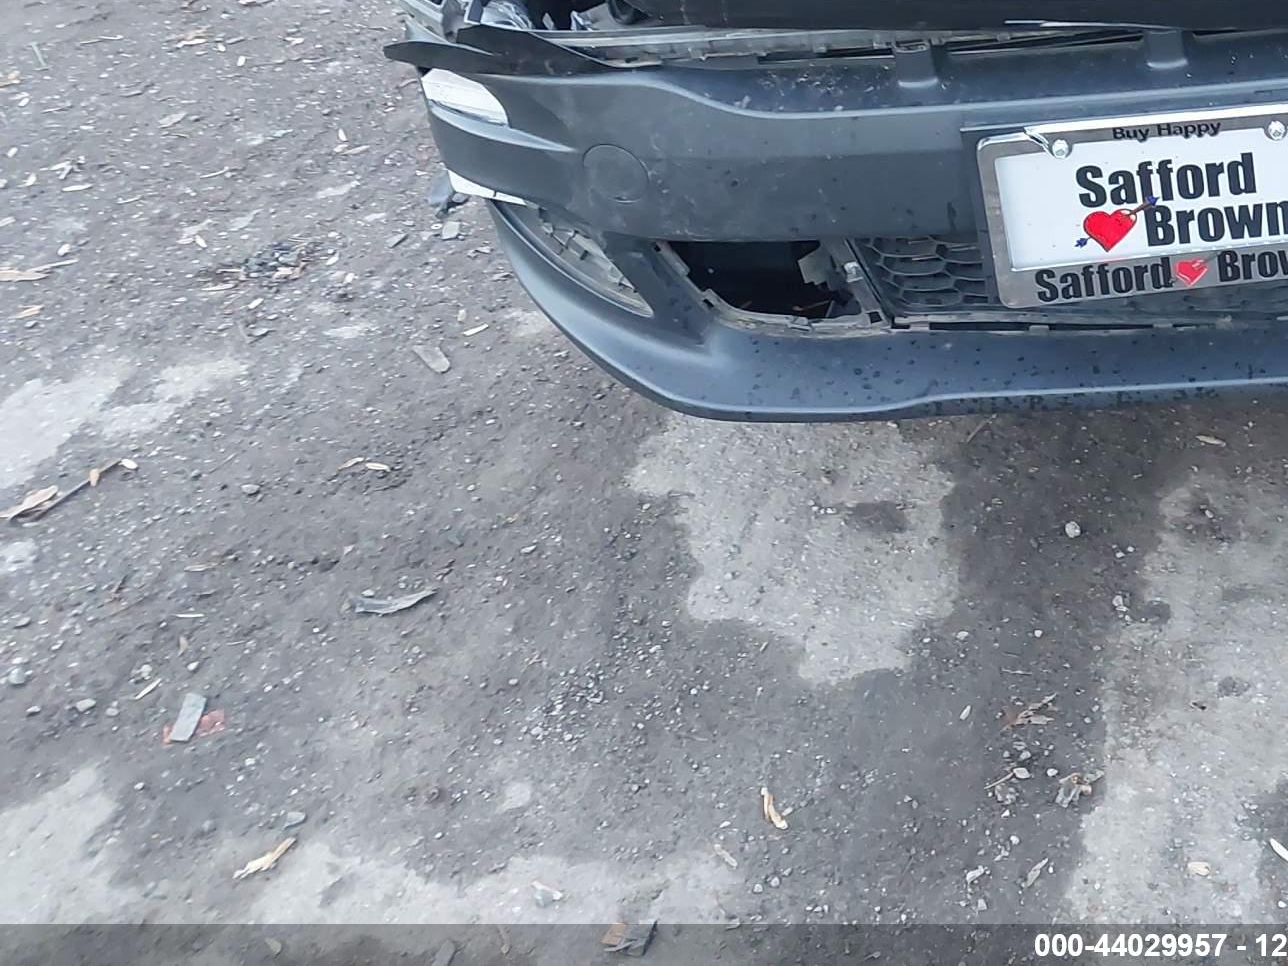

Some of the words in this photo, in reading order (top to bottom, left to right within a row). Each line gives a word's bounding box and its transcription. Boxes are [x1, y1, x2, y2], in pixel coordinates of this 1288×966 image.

[1112, 125, 1149, 143] Buy
[1156, 121, 1222, 140] Happy
[1075, 152, 1257, 208] Safford
[1035, 257, 1174, 302] Safford
